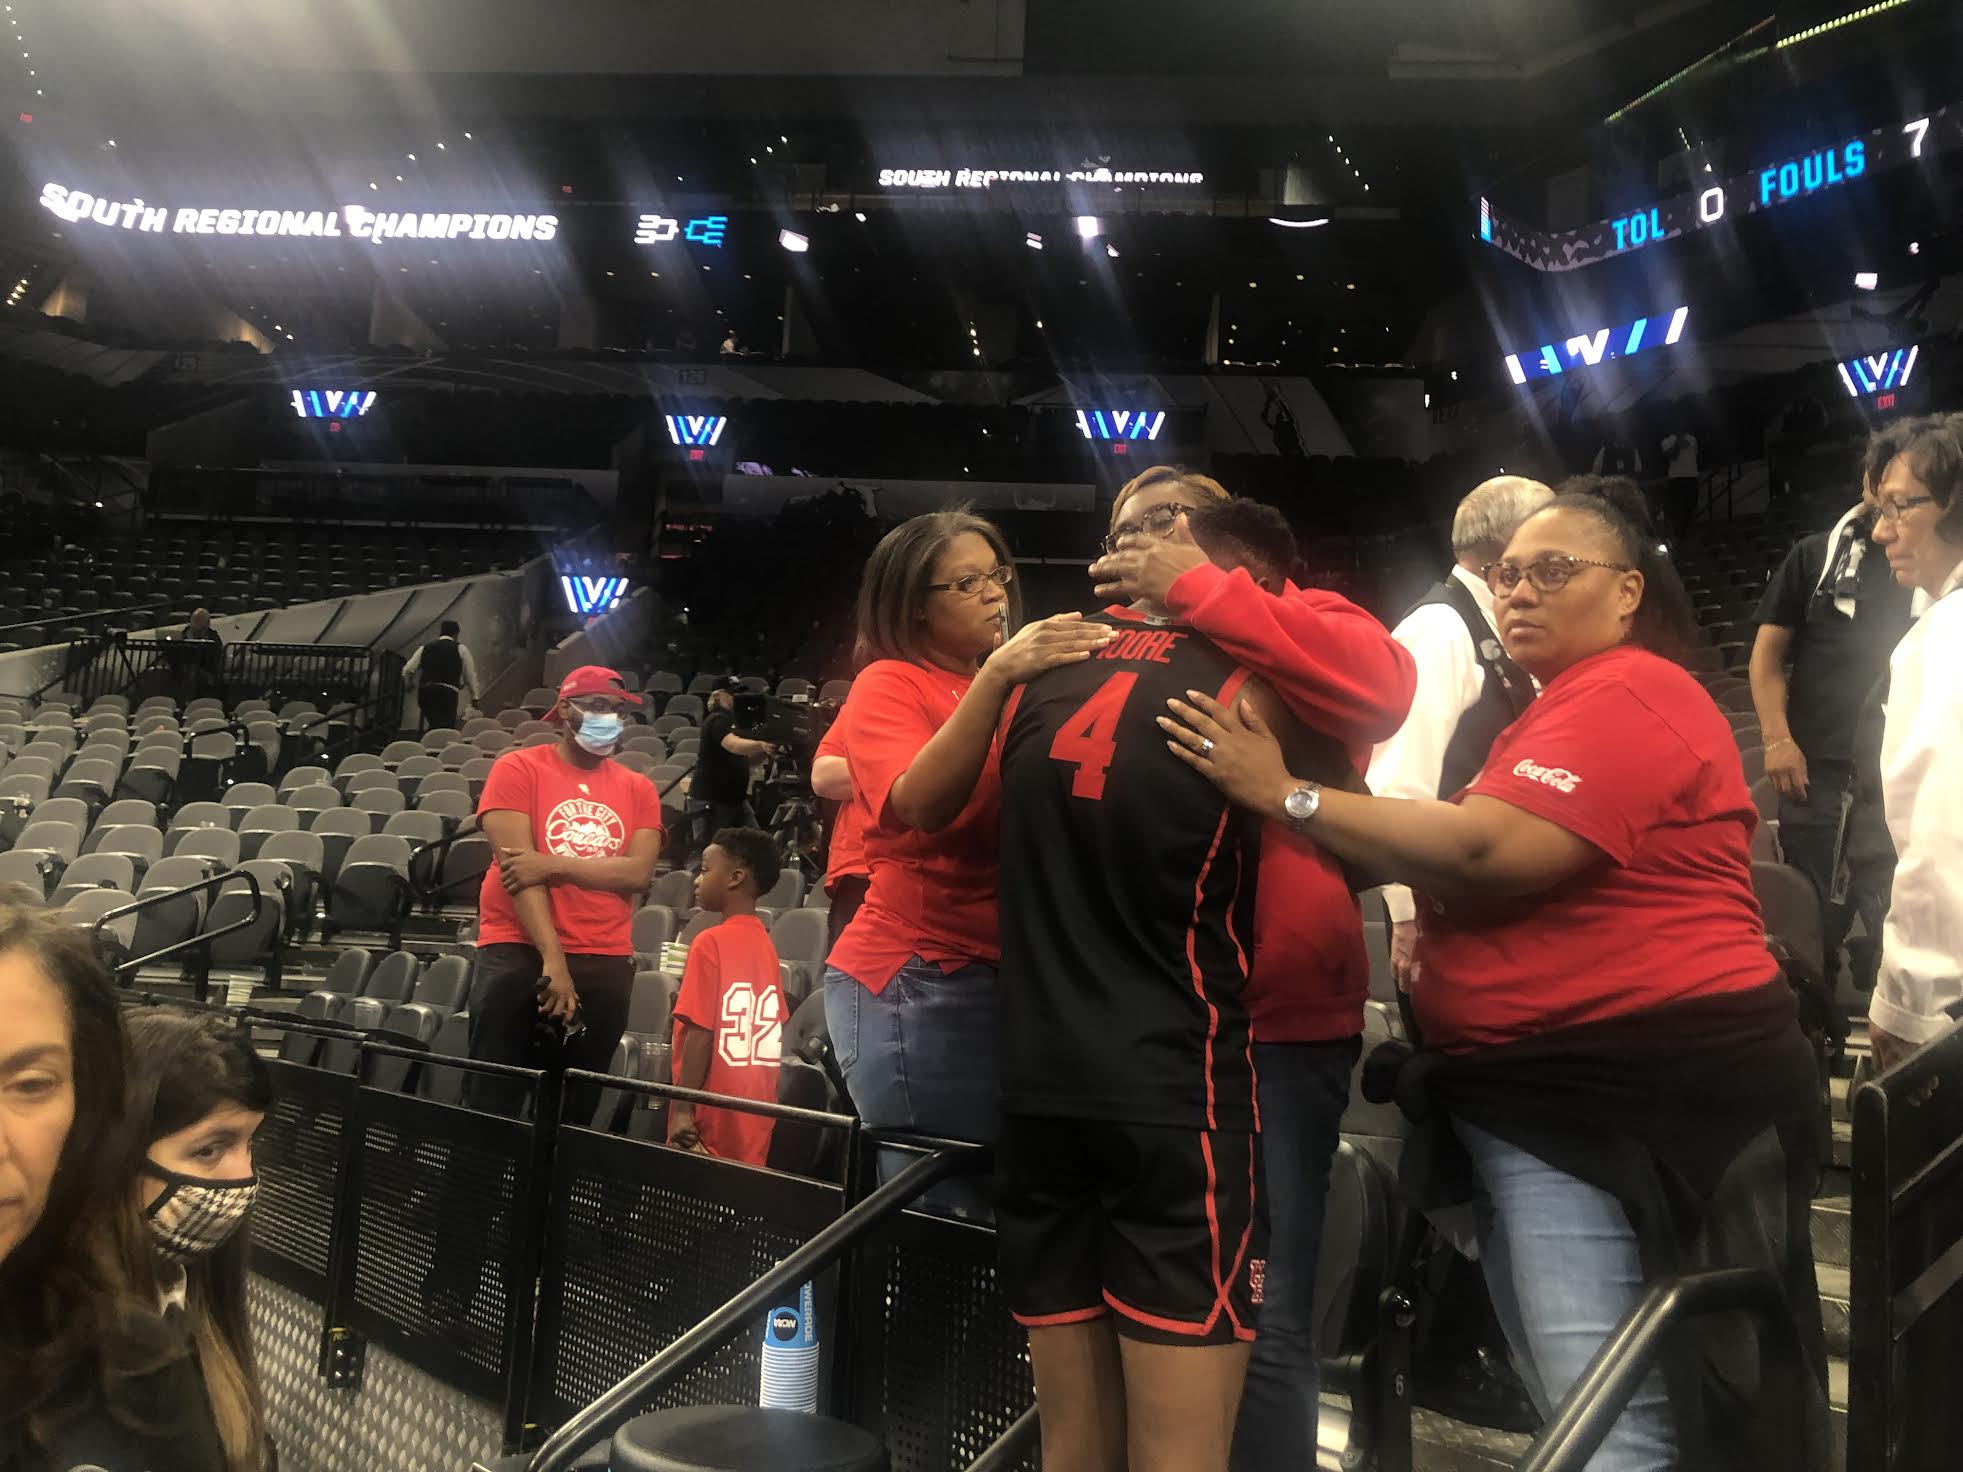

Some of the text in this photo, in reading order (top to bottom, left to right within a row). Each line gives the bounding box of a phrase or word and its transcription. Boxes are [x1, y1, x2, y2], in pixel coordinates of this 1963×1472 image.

[878, 169, 951, 188] SOUTH
[1611, 117, 1930, 251] TOL 0 FOULS 7
[40, 182, 559, 241] SOUTH REGIONAL CHAMPIONS
[1095, 628, 1189, 664] OORE
[1048, 671, 1139, 800] 4
[595, 806, 618, 827] CITY
[718, 982, 783, 1067] 32
[773, 1318, 797, 1329] NCAA
[803, 1280, 814, 1343] OWERADE
[1395, 1373, 1404, 1397] 6
